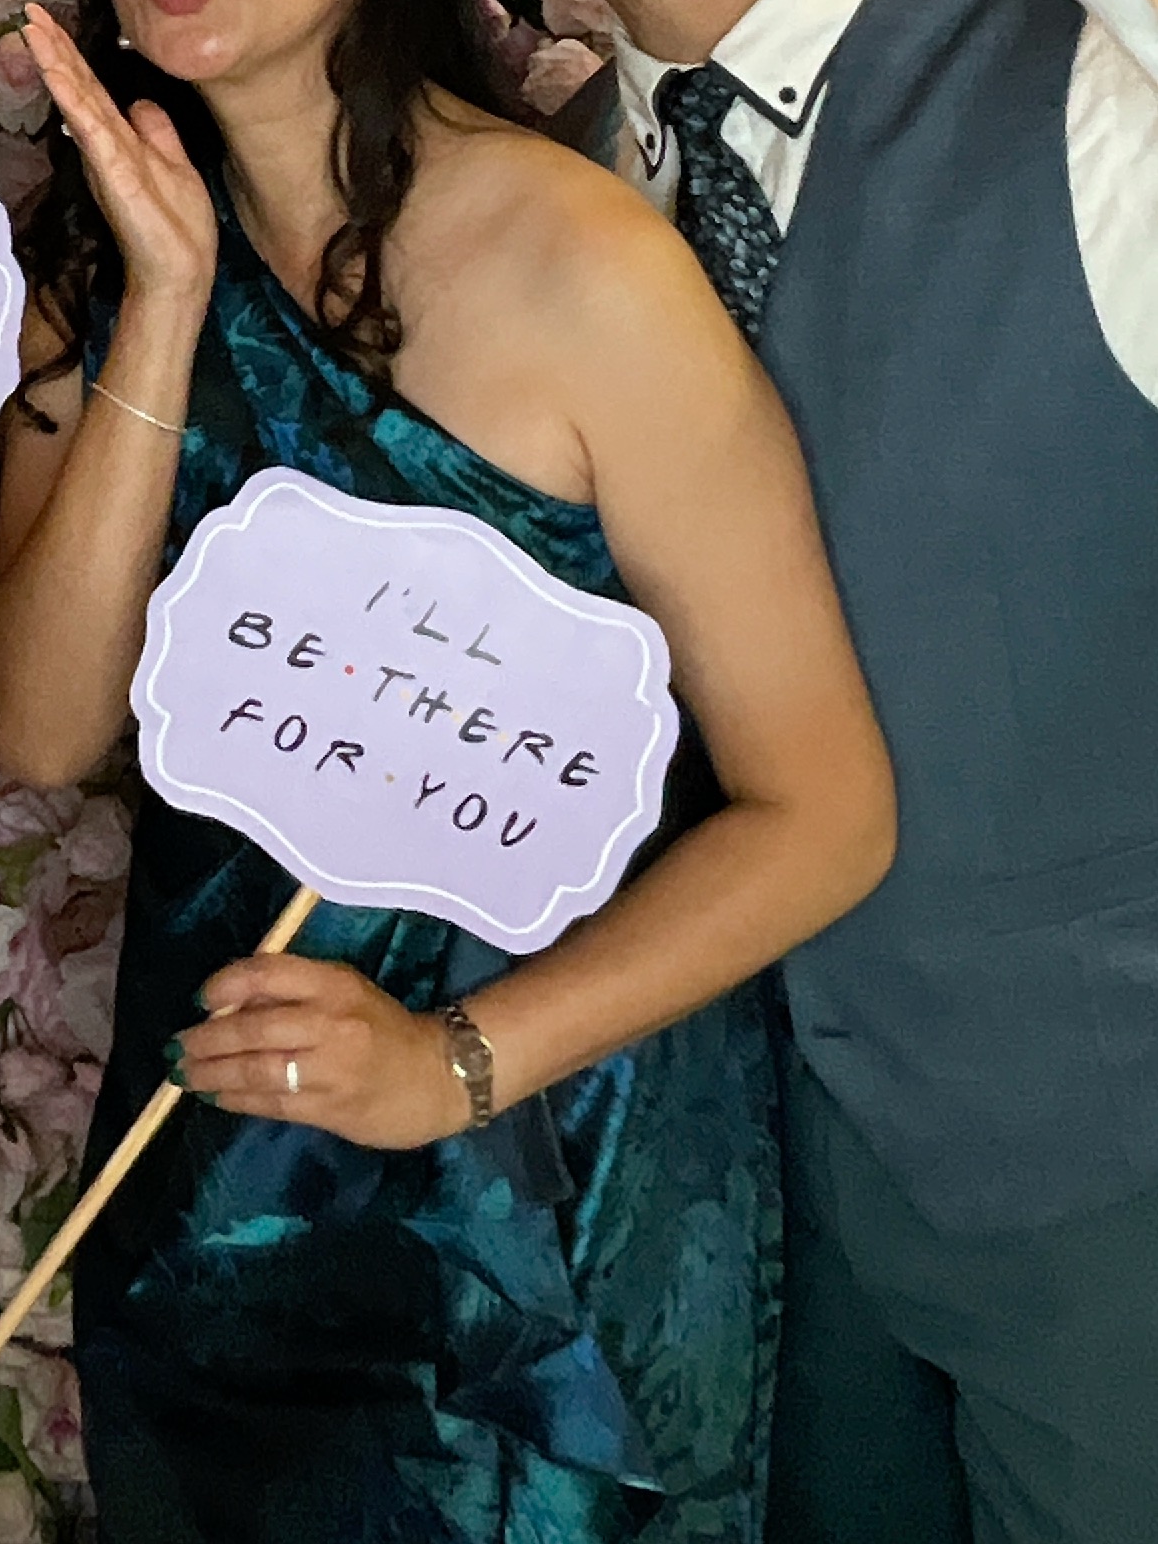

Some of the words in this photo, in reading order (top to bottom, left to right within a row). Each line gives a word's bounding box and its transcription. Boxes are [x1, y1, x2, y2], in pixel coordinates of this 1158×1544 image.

[227, 610, 327, 668] BE
[364, 580, 502, 666] I'LL
[219, 697, 366, 774] FOR
[413, 772, 538, 848] YOU
